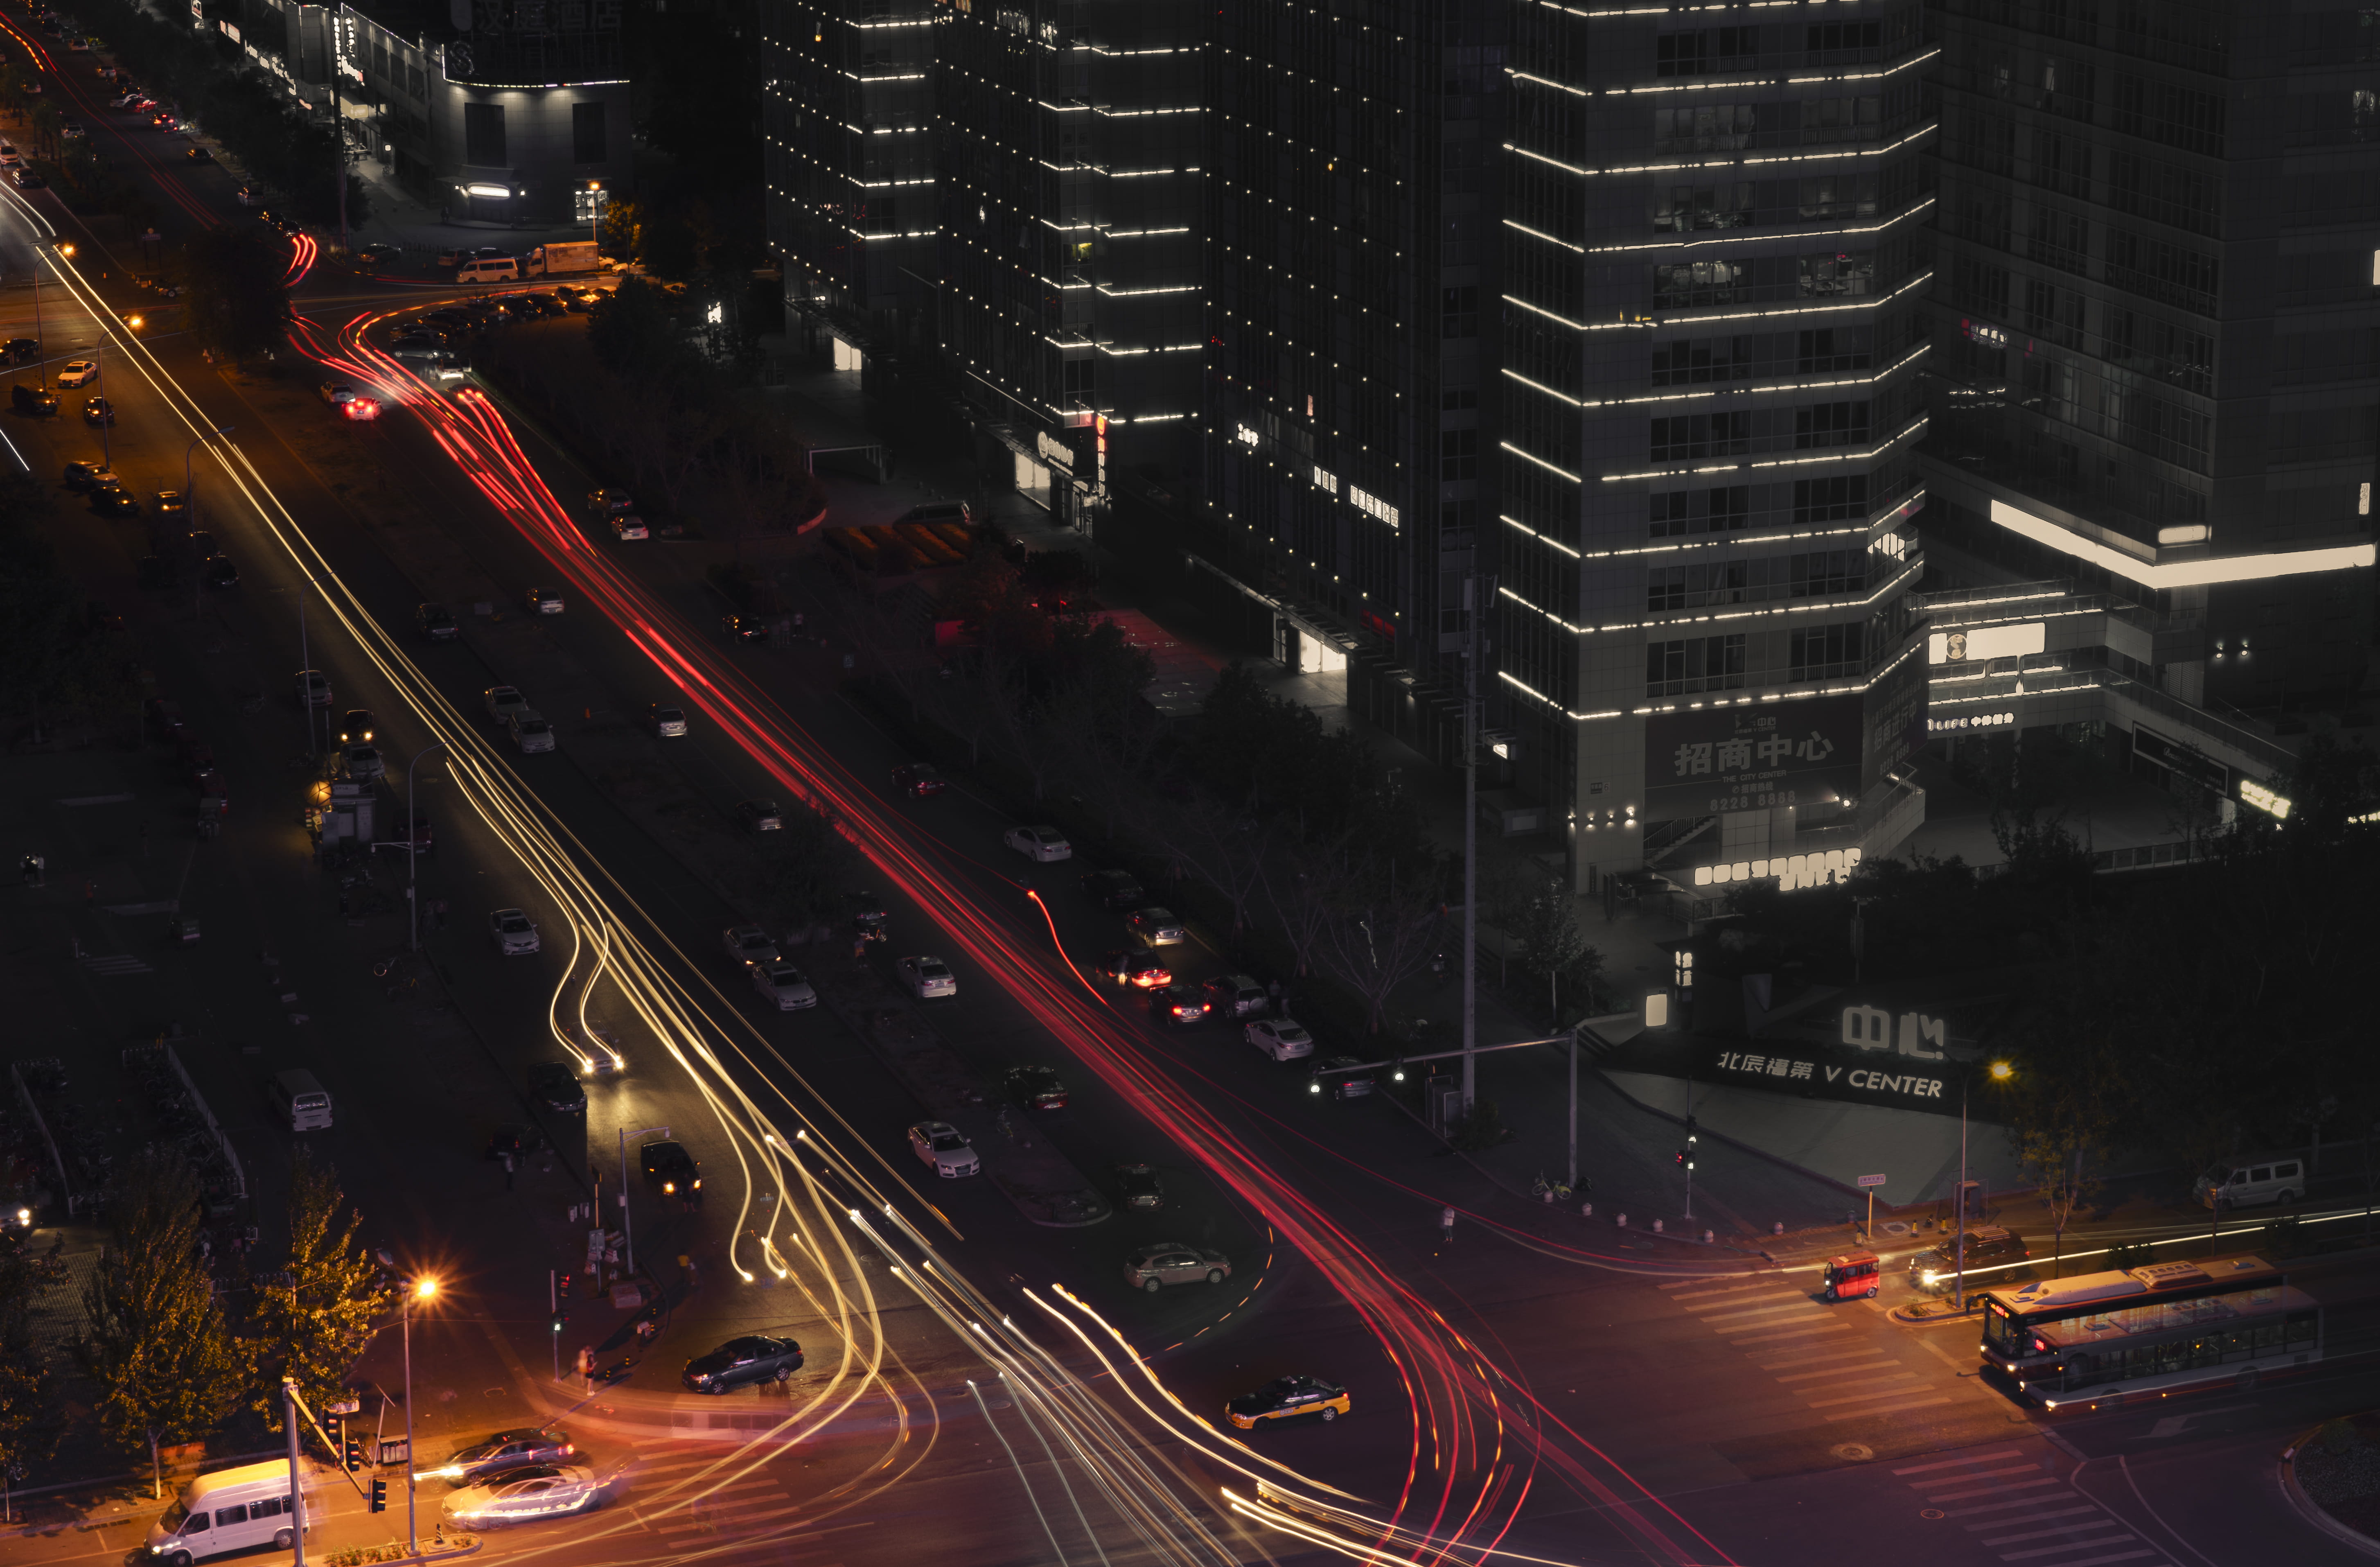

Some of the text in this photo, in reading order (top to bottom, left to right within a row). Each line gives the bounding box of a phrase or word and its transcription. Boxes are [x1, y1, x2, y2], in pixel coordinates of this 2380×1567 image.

[1874, 698, 1917, 753] 招商进行中
[1674, 730, 1834, 776] 招商中心
[1741, 782, 1773, 794] 招商热线
[1758, 770, 1787, 779] CENTER
[1710, 790, 1796, 811] 8228 8888
[1843, 1005, 1944, 1060] 中心
[1717, 1051, 1814, 1079] 北辰福第
[1824, 1066, 1943, 1097] V CENTER
